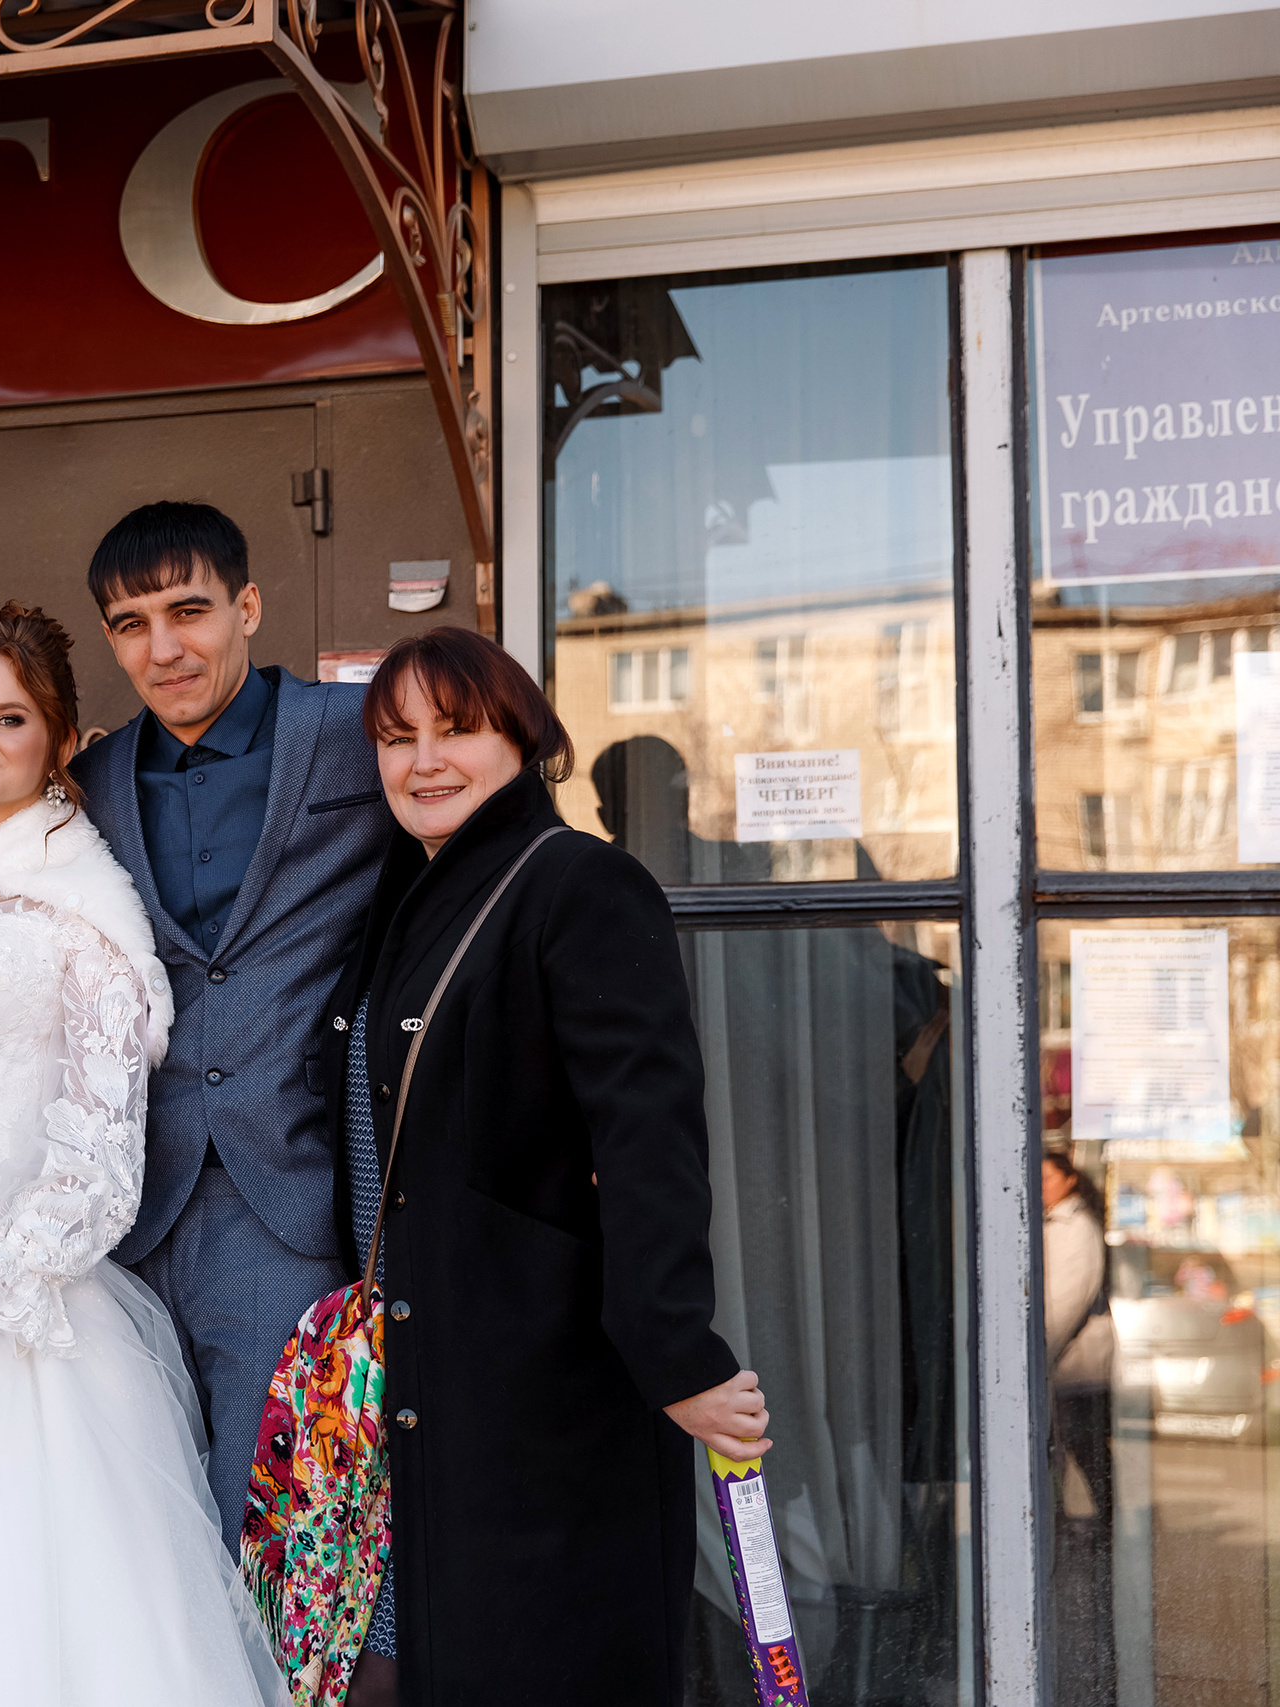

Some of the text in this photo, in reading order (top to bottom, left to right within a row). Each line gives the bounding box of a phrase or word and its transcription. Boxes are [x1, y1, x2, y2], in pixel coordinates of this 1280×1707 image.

[1060, 476, 1280, 544] граждан
[755, 754, 839, 770] Внимание!
[758, 787, 838, 802] ЧЕТВЕРГ
